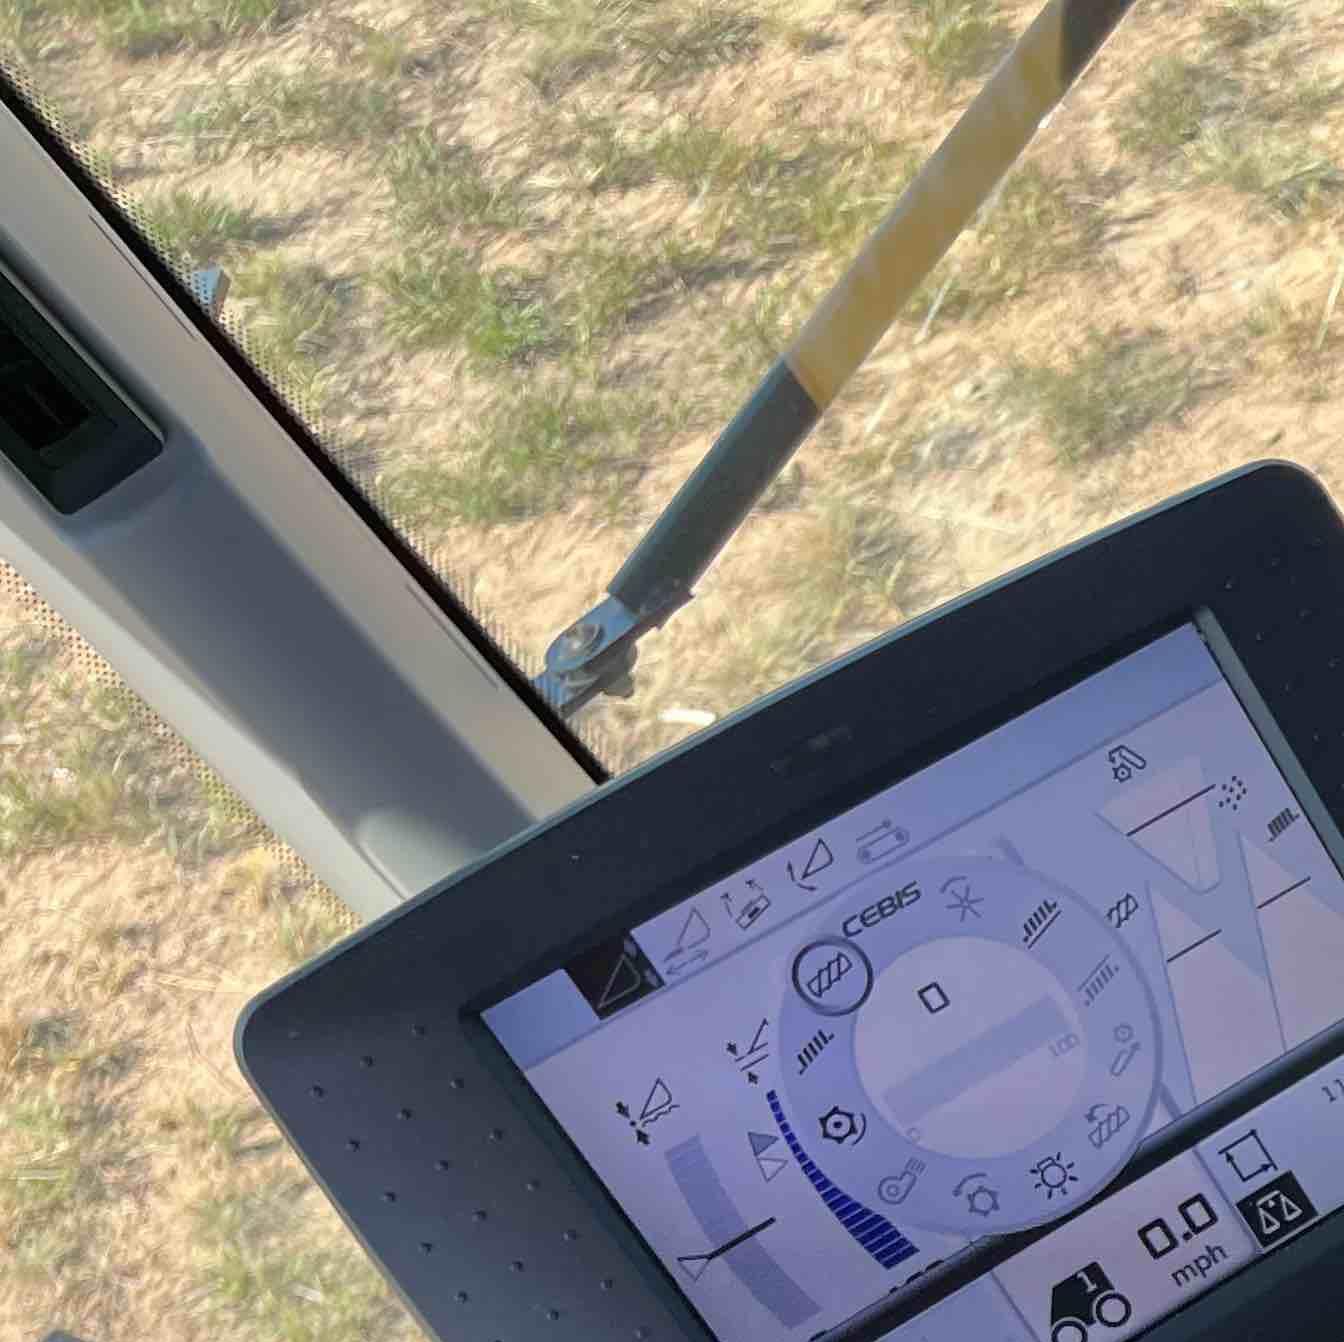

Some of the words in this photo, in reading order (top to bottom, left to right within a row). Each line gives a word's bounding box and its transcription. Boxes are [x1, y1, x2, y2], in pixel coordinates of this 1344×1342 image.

[842, 881, 921, 937] CEBIS
[1137, 1193, 1218, 1260] 0.0
[1171, 1243, 1229, 1287] mph
